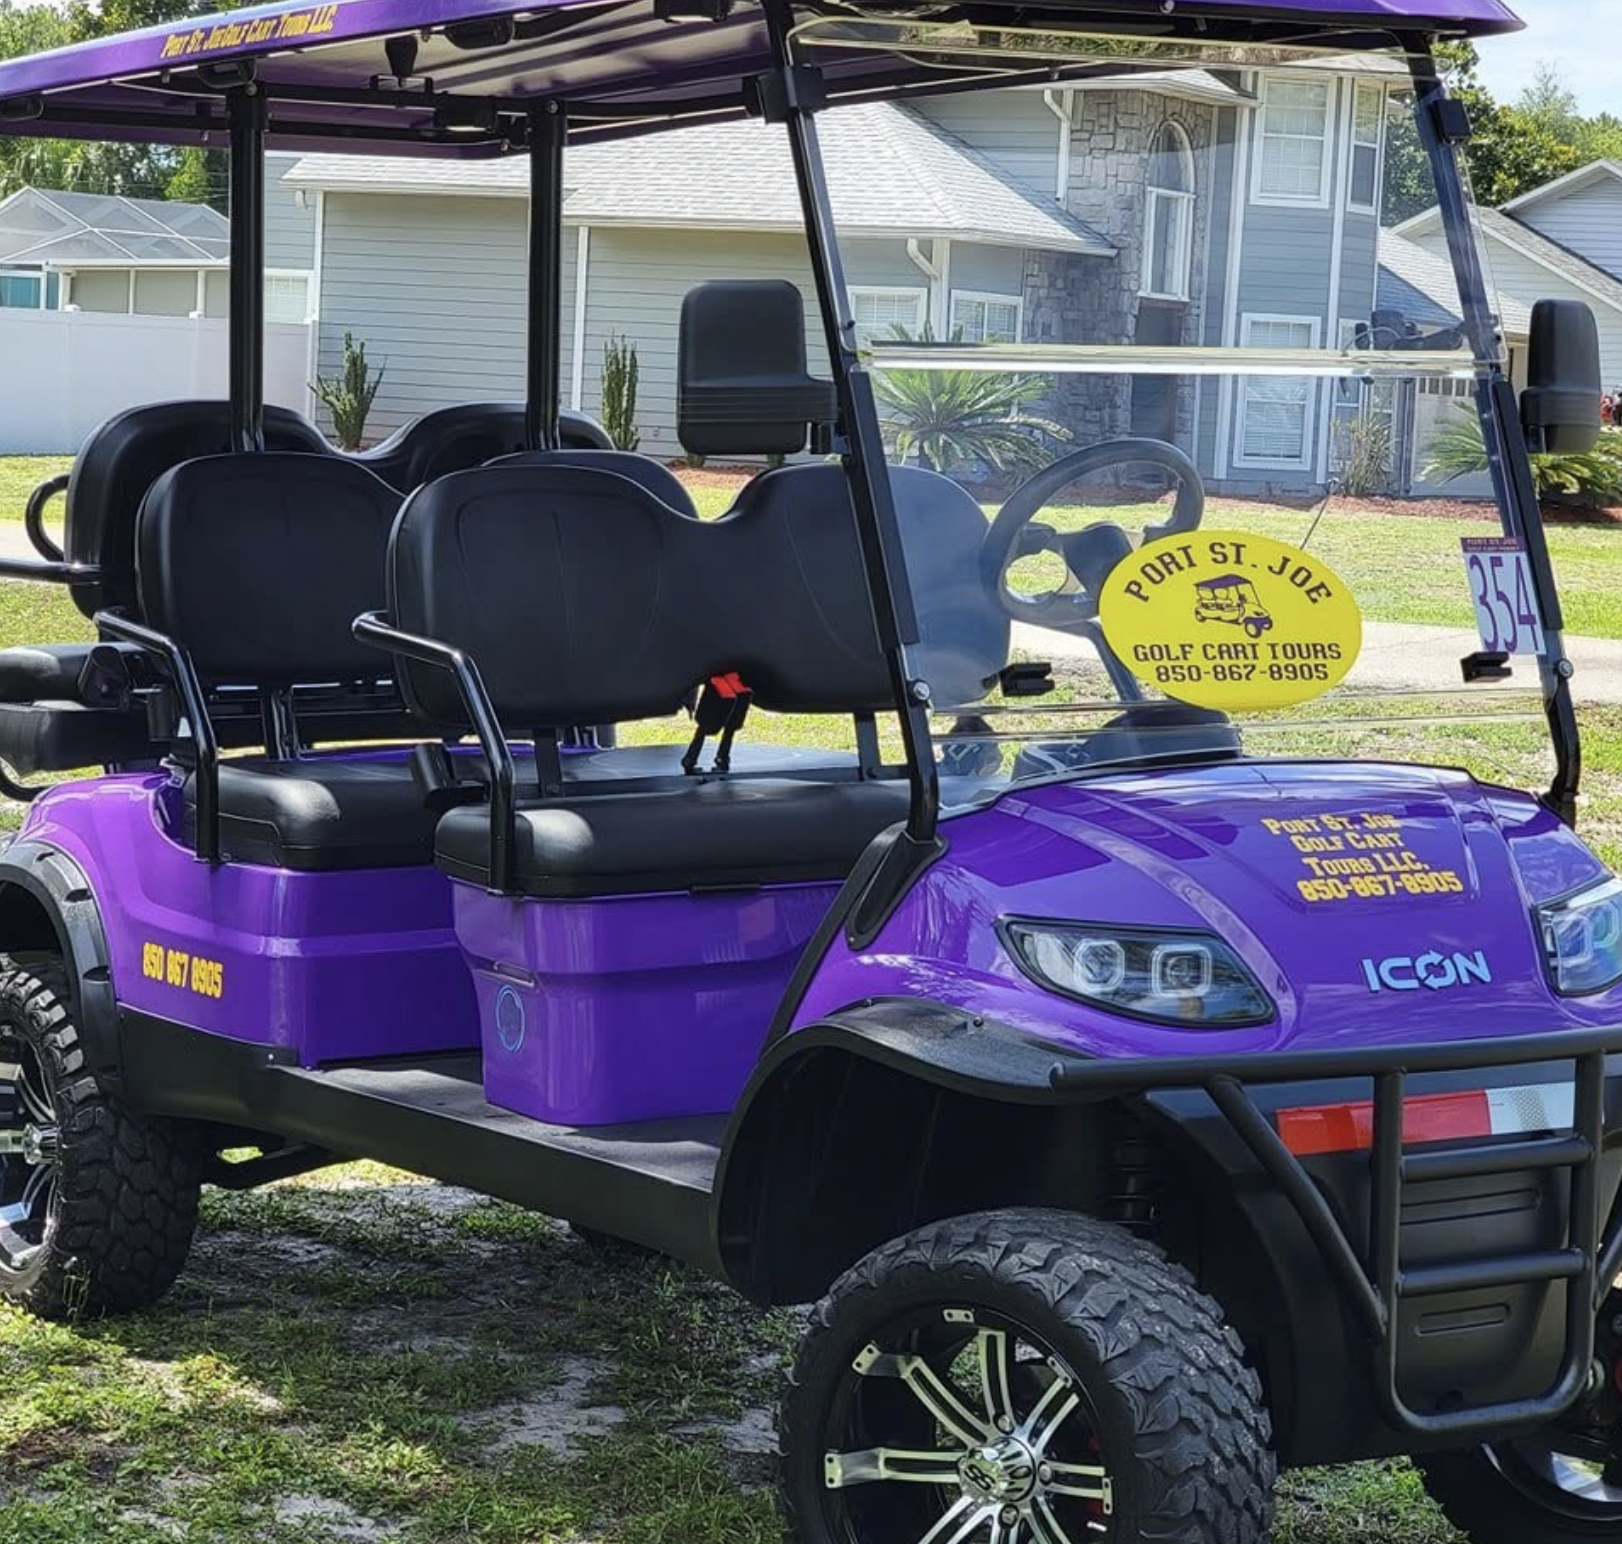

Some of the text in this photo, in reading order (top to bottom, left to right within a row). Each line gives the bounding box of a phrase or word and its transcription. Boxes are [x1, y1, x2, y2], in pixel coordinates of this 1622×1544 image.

[1124, 542, 1333, 605] PORT ST. JOE
[1469, 554, 1539, 653] 354
[1132, 642, 1342, 662] GOLF CART TOURS
[1155, 662, 1329, 683] 850-867-8905
[1372, 851, 1431, 873] LLC.
[1296, 871, 1464, 902] 850-867-8905
[143, 941, 165, 981] 850
[1361, 949, 1492, 992] ICON
